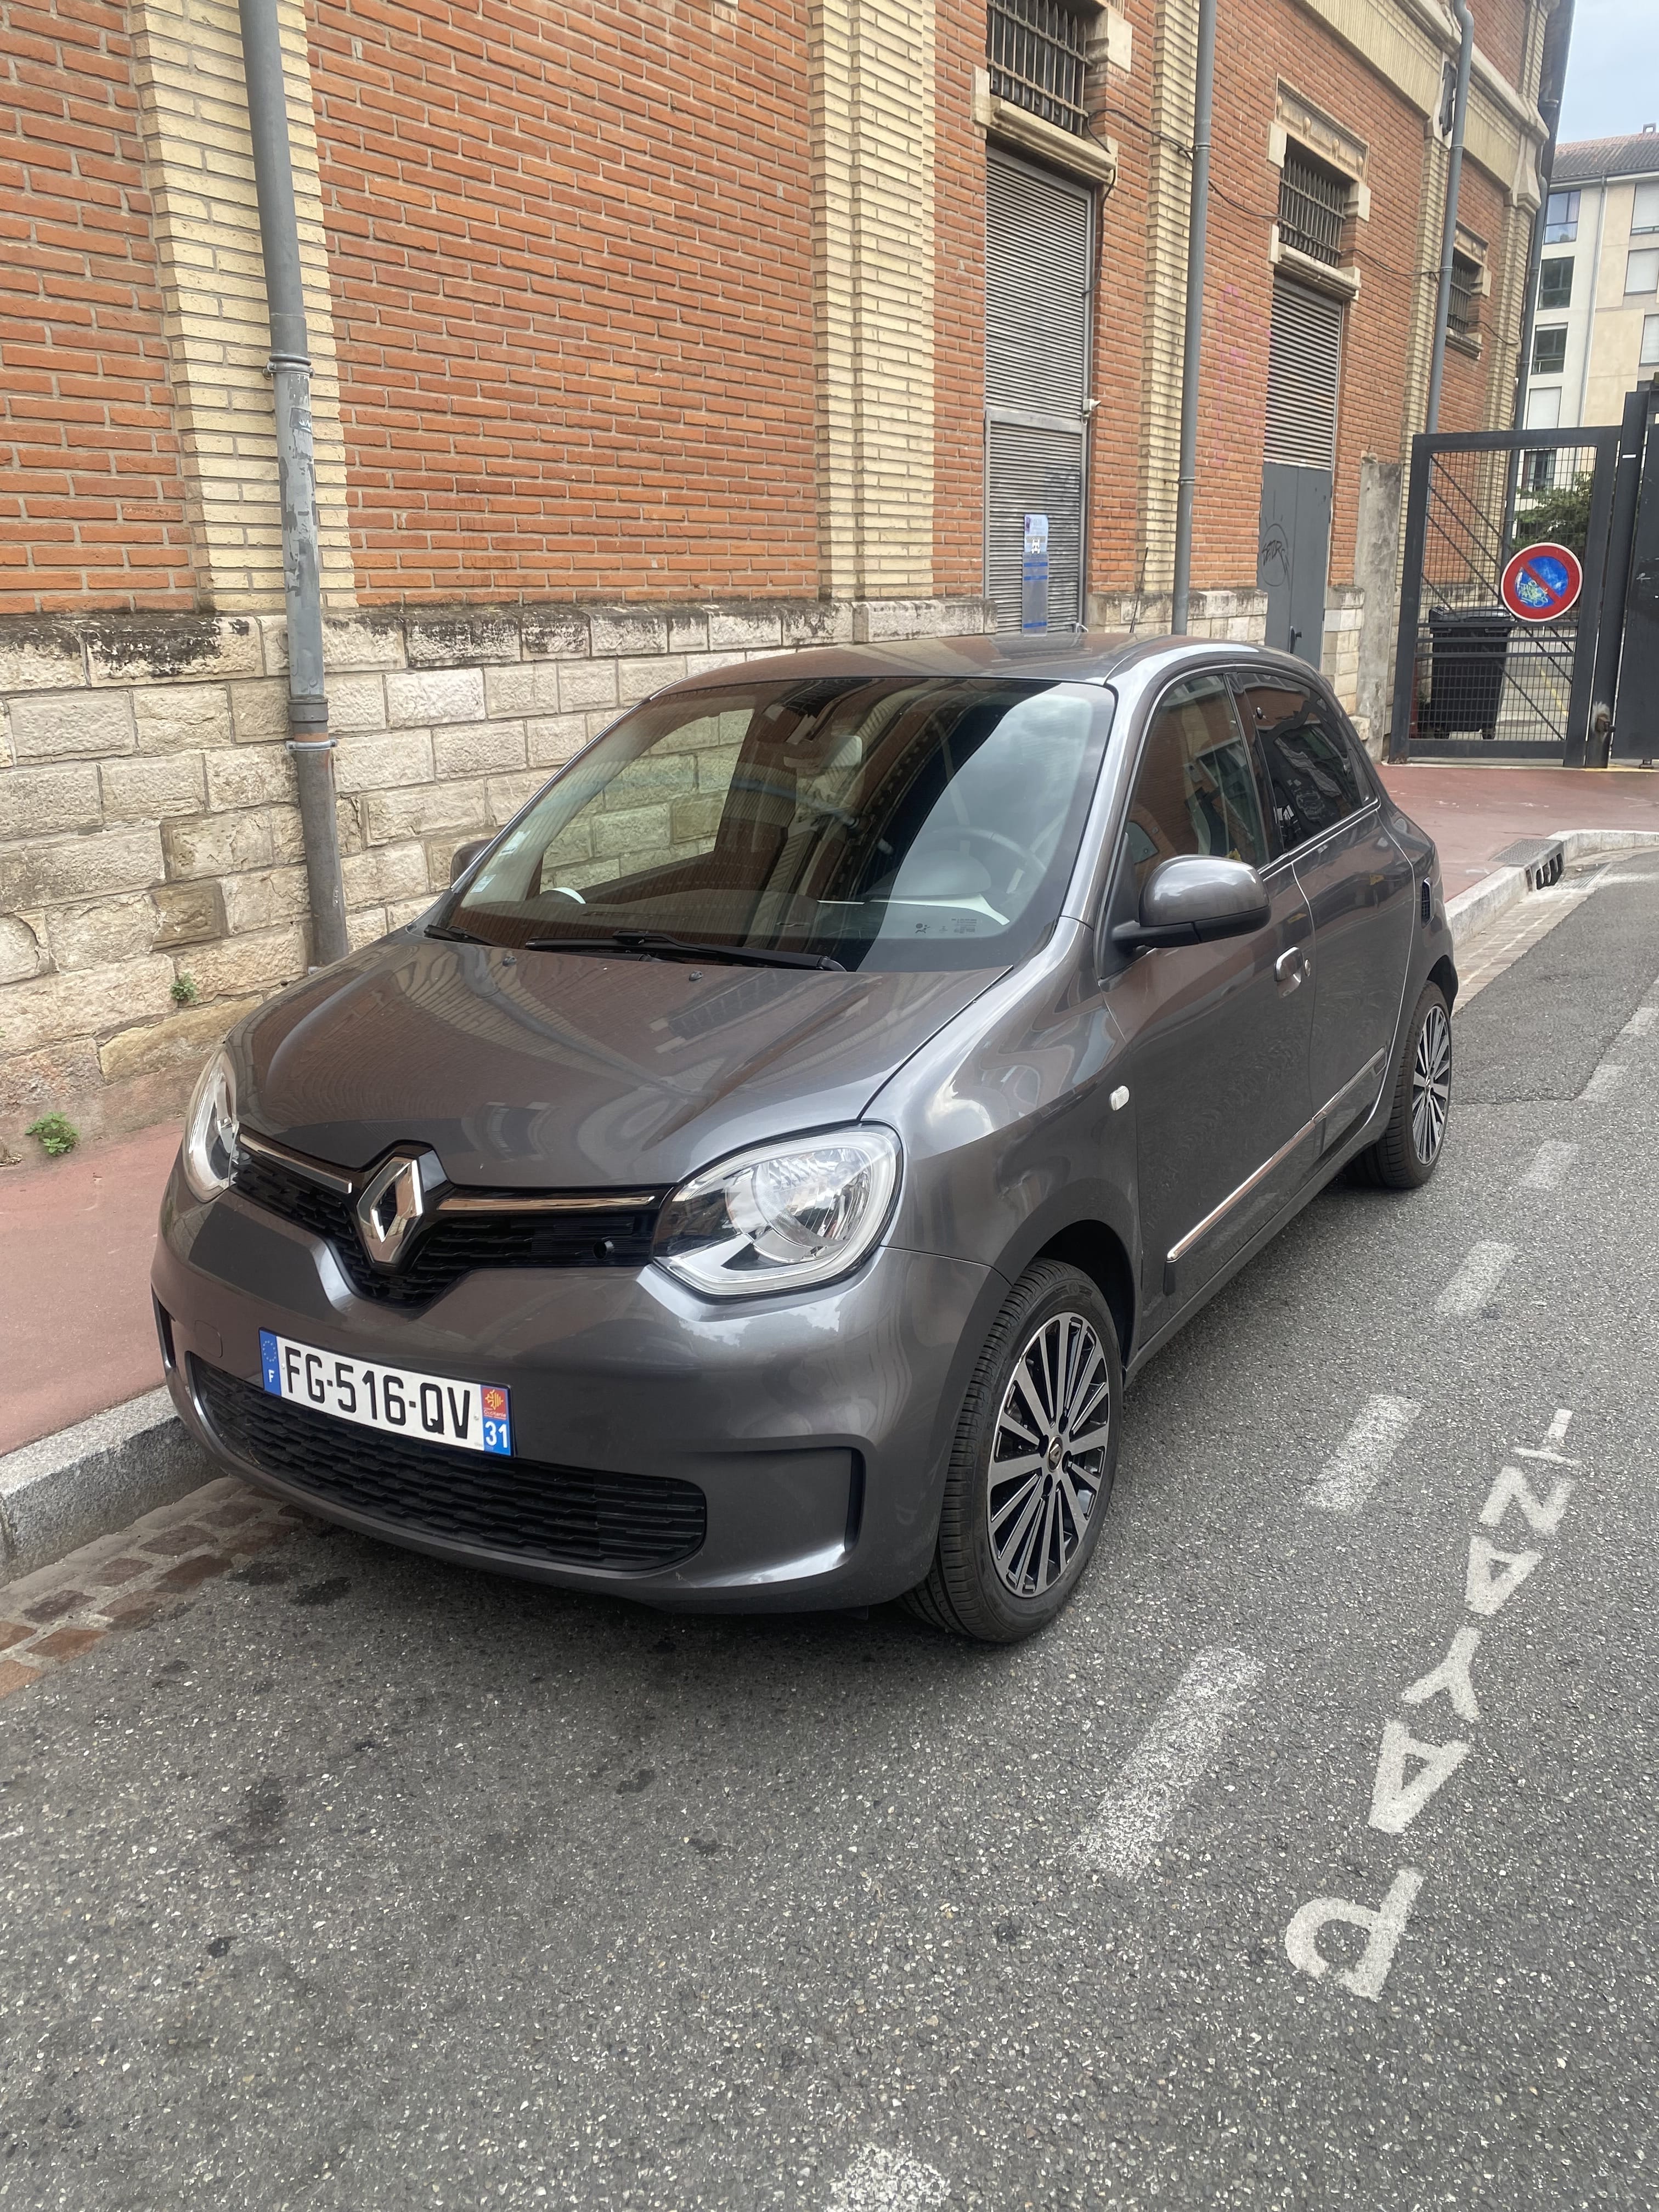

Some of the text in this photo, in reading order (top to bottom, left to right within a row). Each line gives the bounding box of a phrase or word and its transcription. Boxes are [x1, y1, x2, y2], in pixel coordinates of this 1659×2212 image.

[268, 1369, 274, 1383] F
[284, 1346, 471, 1440] FG-516-QV
[485, 1421, 507, 1448] 31
[1285, 1408, 1581, 2001] PAYANT
